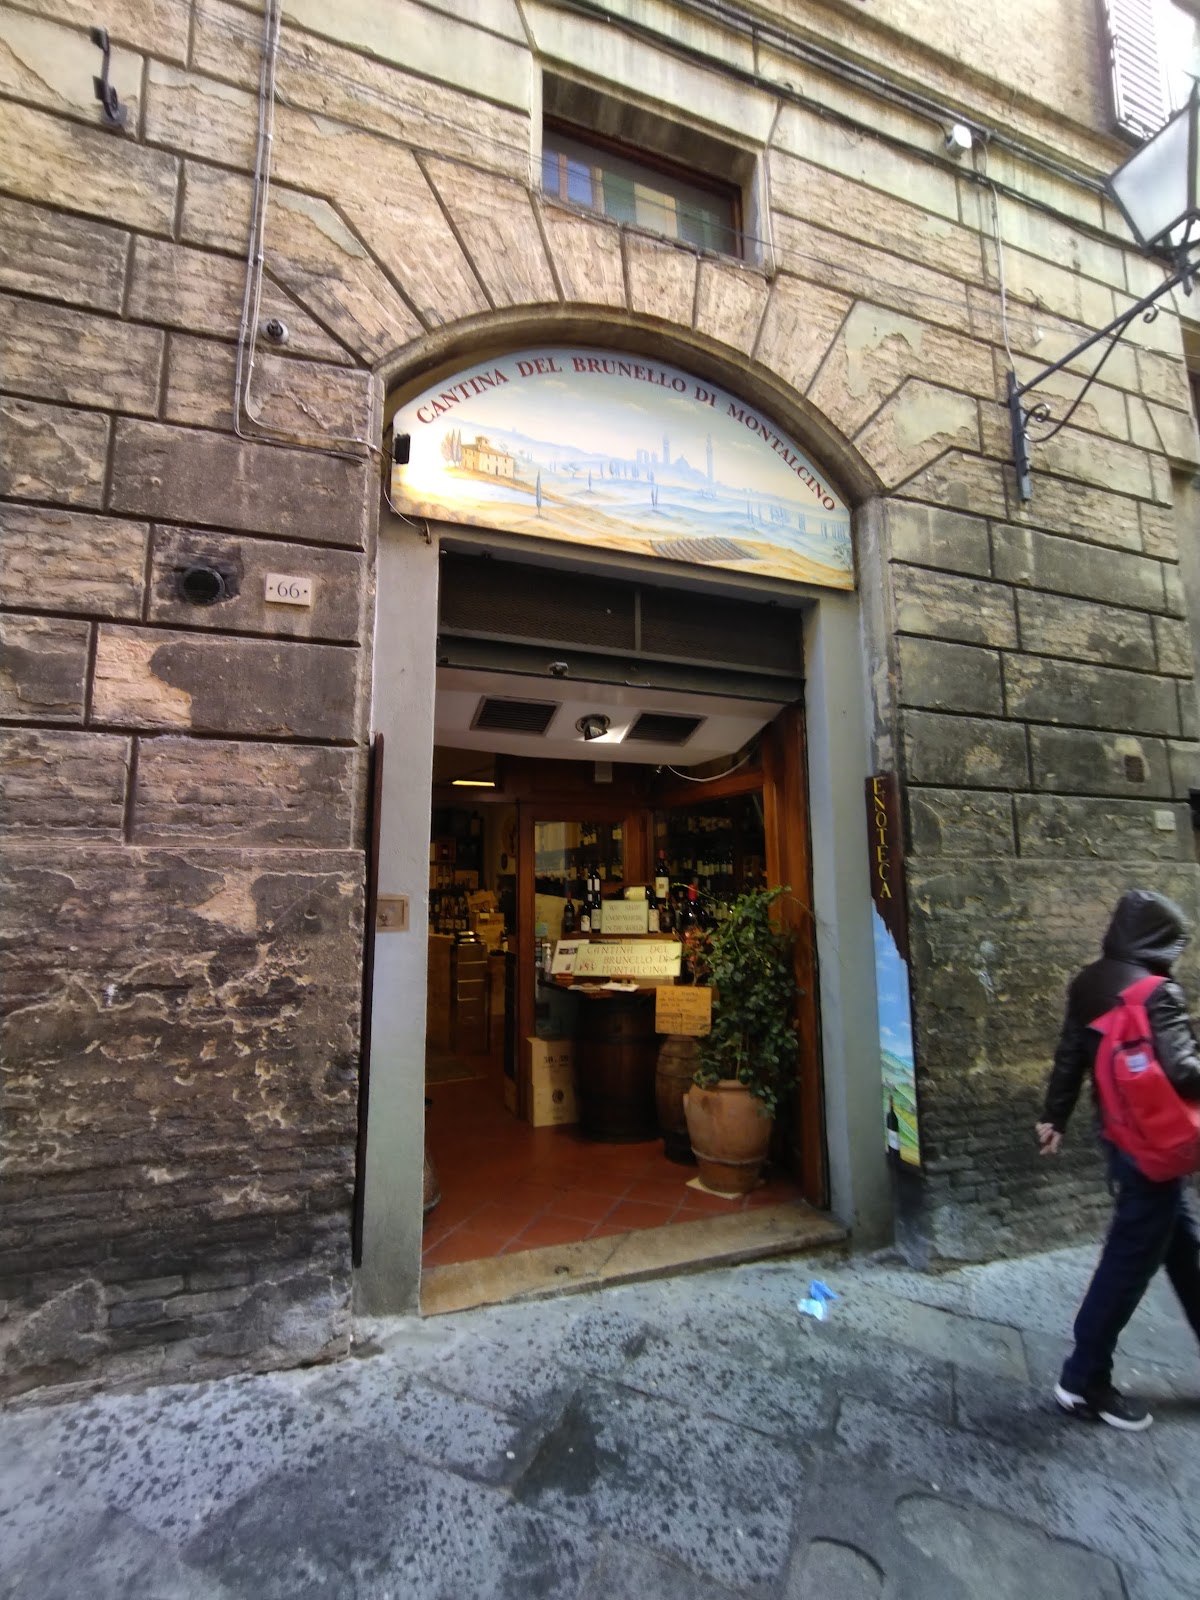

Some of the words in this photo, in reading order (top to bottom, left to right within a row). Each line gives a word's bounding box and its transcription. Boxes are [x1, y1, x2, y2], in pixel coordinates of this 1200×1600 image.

[416, 368, 509, 424] CANTINA
[515, 357, 562, 377] DEL
[571, 357, 687, 393] BRUNELLO
[694, 386, 717, 408] DI
[726, 402, 836, 511] MONTALCINO
[277, 580, 300, 599] 66
[873, 777, 892, 898] ENOTECA
[586, 945, 633, 954] CANTINA
[649, 945, 668, 954] DEL
[603, 955, 653, 964] BRUNELLO
[602, 965, 668, 974] MONTALCINO
